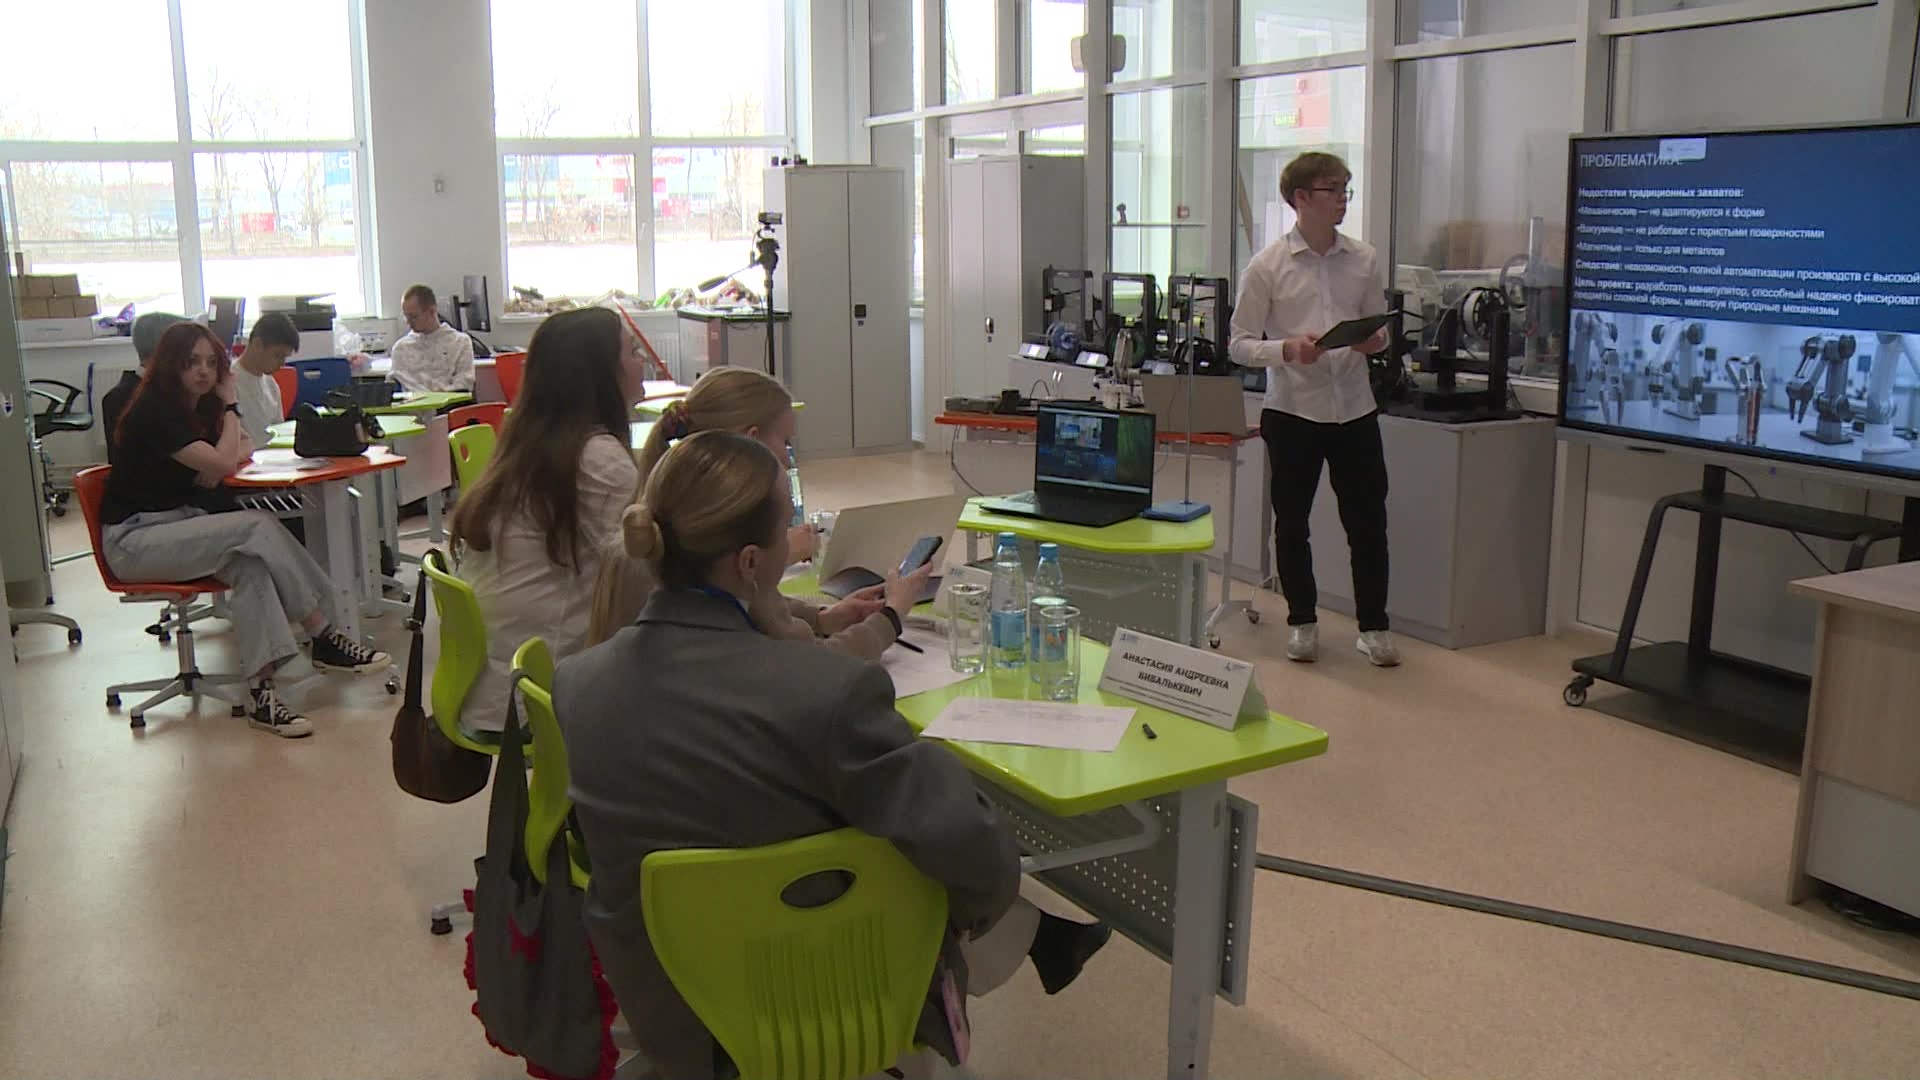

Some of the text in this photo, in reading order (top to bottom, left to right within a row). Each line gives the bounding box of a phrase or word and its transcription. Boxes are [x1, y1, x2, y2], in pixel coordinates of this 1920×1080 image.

[1578, 187, 1744, 199] Недостатки традиционных захватов:
[1662, 208, 1723, 219] адаптируются
[1732, 207, 1765, 219] форме
[1648, 225, 1688, 236] работают
[1697, 227, 1747, 239] пористыми
[1749, 229, 1825, 240] поверхностями
[1663, 246, 1680, 256] для
[1682, 247, 1725, 257] металлов
[1690, 264, 1722, 275] полной
[1723, 267, 1794, 280] автоматизации
[1797, 270, 1861, 283] производств
[1864, 273, 1871, 281] с
[1635, 281, 1687, 293] разработать
[1689, 285, 1750, 298] манипулятор,
[1752, 288, 1805, 300] способный
[1807, 291, 1852, 303] надежно
[1728, 301, 1780, 312] природные
[1783, 304, 1839, 316] механизмы
[1122, 652, 1174, 673] АНАСТАСИЯ
[1175, 667, 1229, 689] АНДРЕЕВНА
